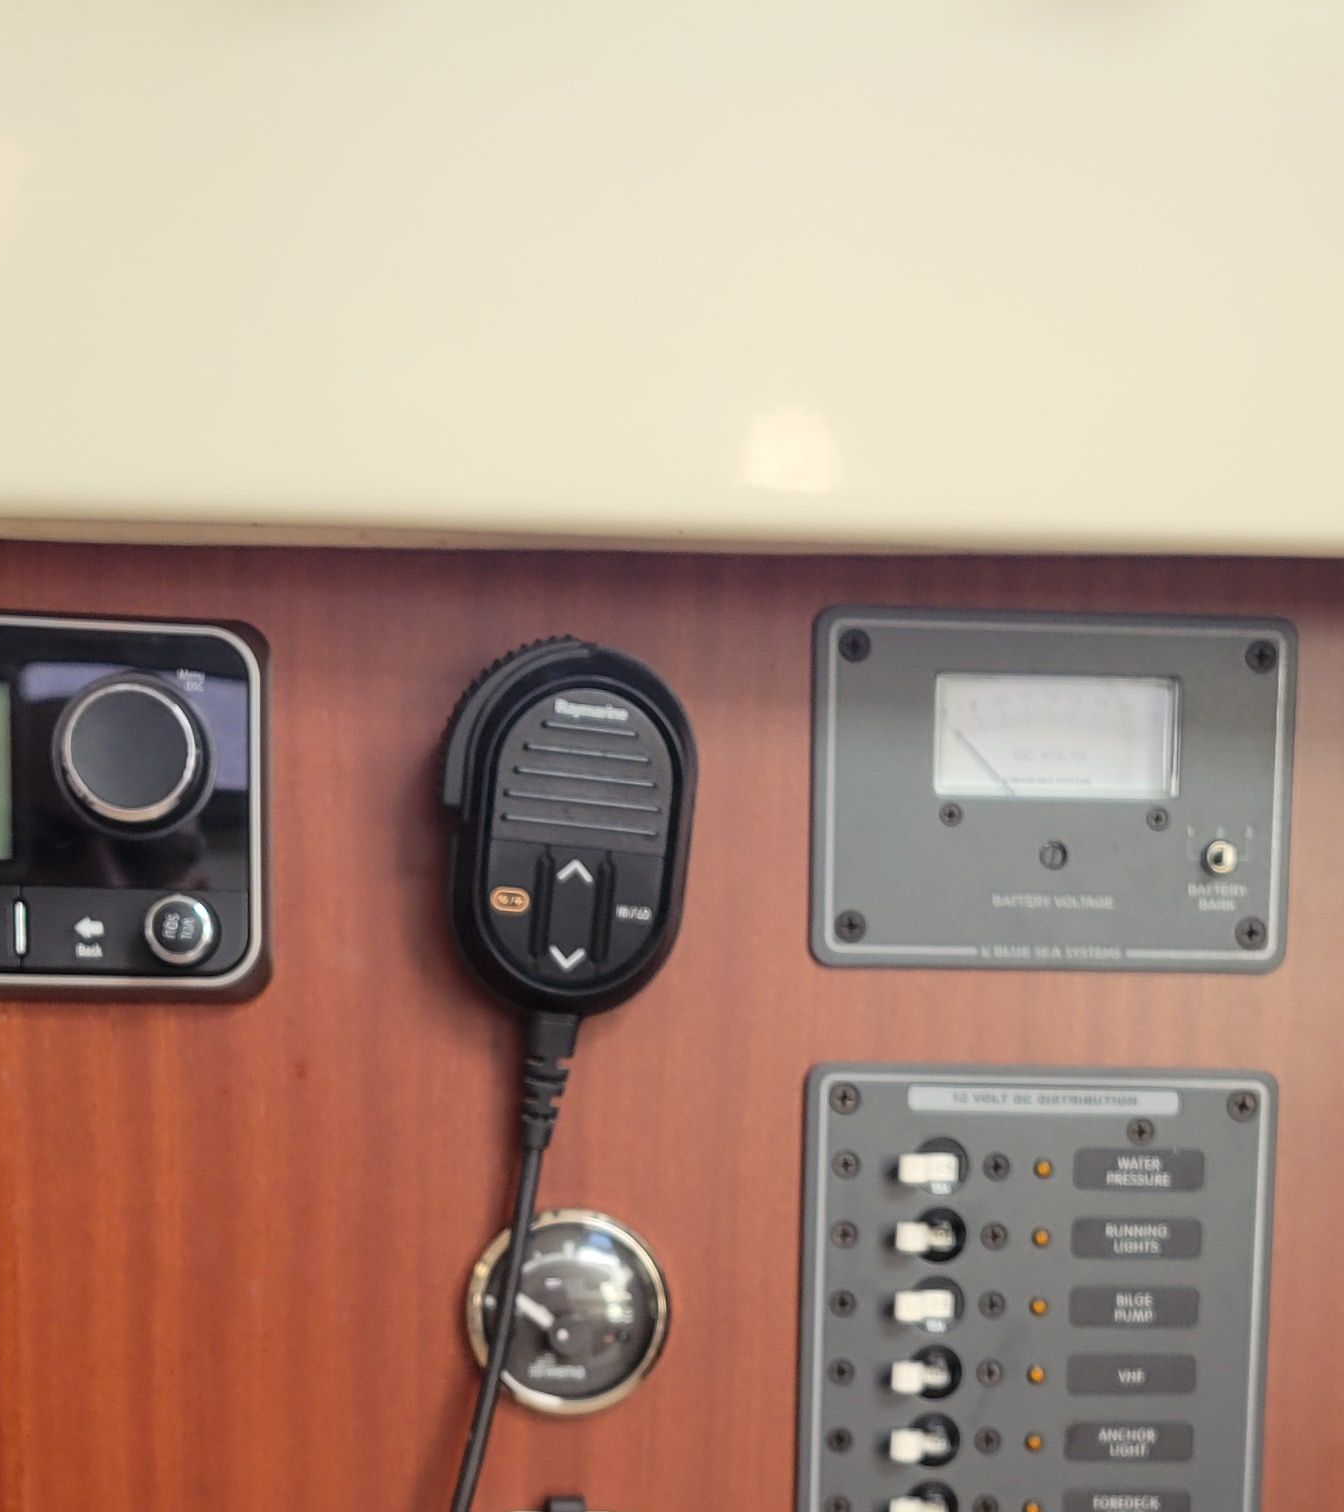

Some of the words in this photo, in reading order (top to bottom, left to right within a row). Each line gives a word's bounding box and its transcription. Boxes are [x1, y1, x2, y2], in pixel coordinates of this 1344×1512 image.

[555, 699, 629, 720] Raymarine
[1187, 882, 1248, 897] BATTERY
[991, 894, 1051, 908] BATTERY
[1054, 894, 1114, 910] VOLTAGE
[1198, 898, 1236, 911] BANK
[75, 941, 103, 958] Back
[993, 945, 1032, 959] BLUE
[1034, 945, 1062, 960] SEA
[1065, 945, 1122, 960] SYSTEMS
[973, 1093, 1009, 1105] VOLT
[1037, 1094, 1138, 1106] DISTRIBUTION
[1117, 1155, 1161, 1170] WATER
[1105, 1170, 1171, 1187] PRESSURE
[1104, 1223, 1170, 1239] RUNNING
[1113, 1239, 1160, 1254] LIGHTS
[1116, 1291, 1153, 1307] BILGE
[1114, 1307, 1154, 1322] PUMP
[1117, 1367, 1146, 1383] VHF
[1098, 1427, 1157, 1443] ANCHOR
[1109, 1443, 1147, 1457] LIGHT
[1092, 1494, 1161, 1511] FOREDECK
